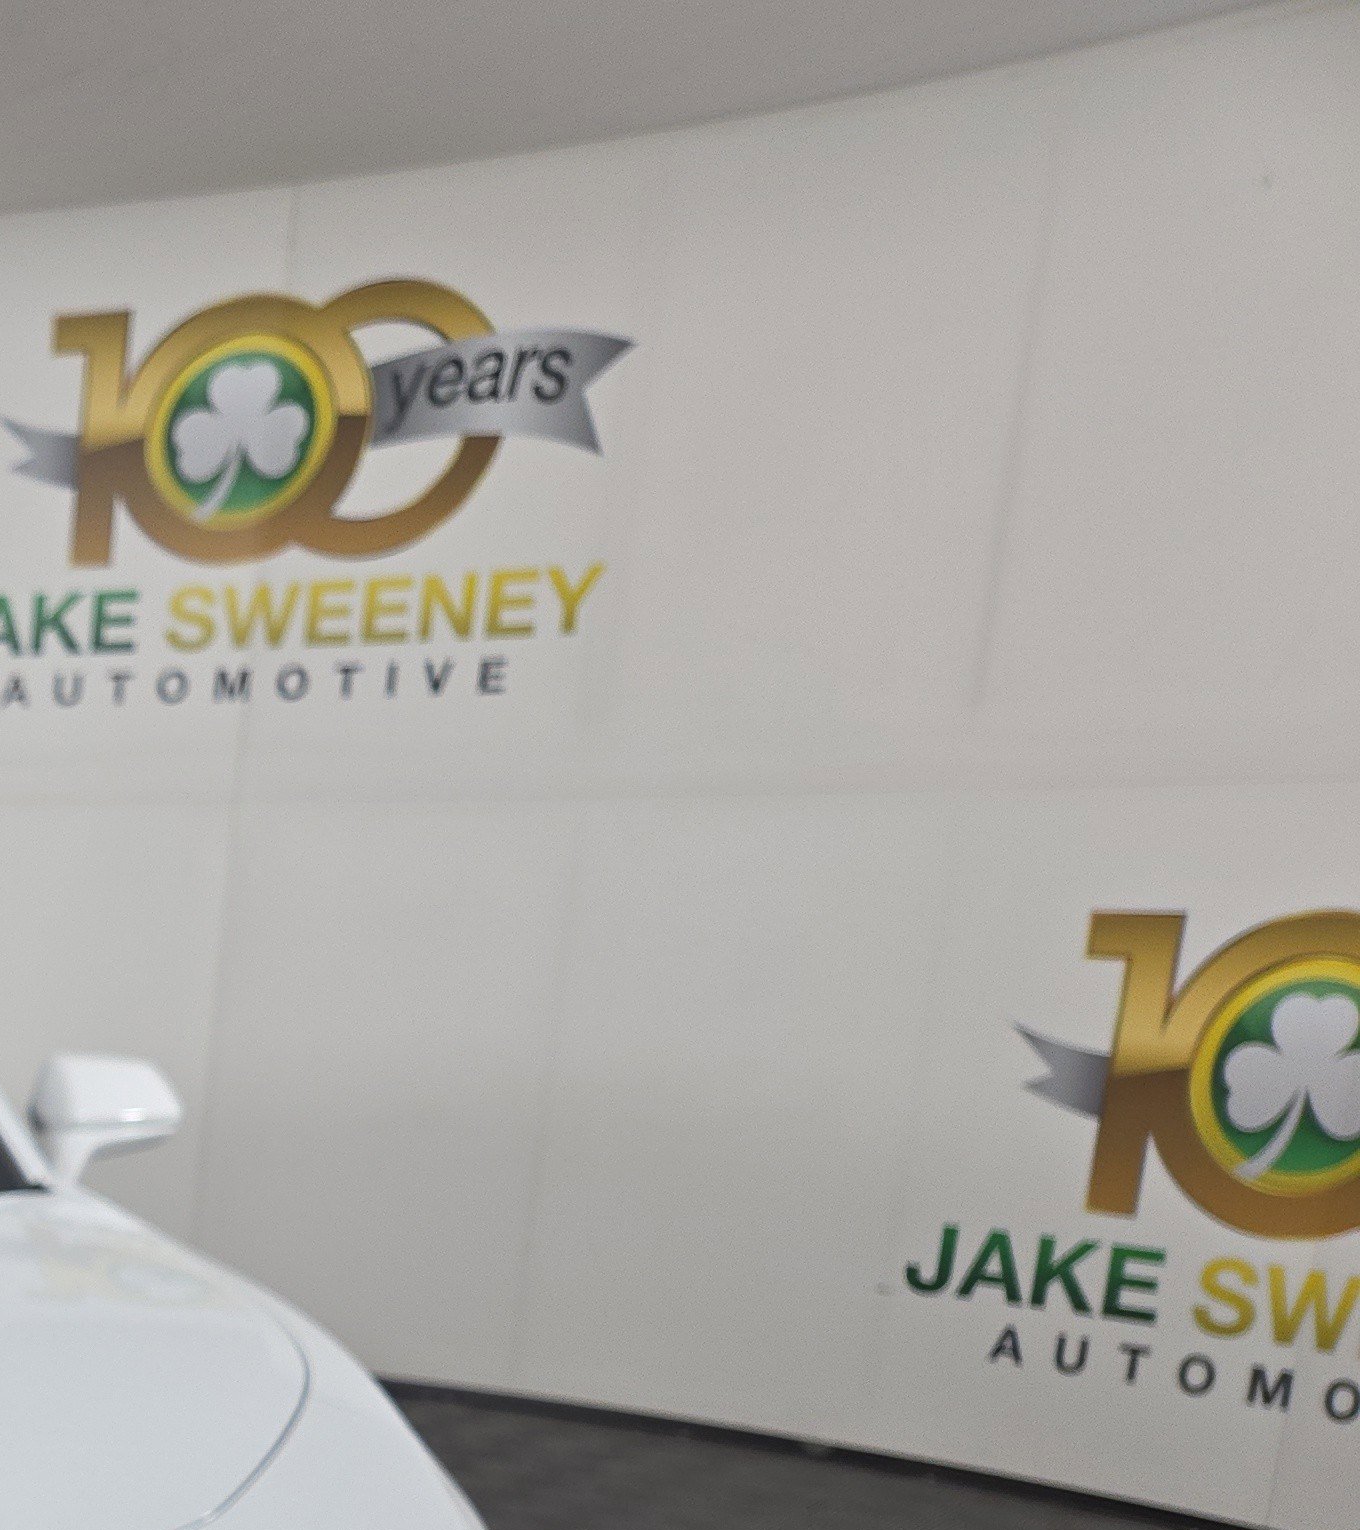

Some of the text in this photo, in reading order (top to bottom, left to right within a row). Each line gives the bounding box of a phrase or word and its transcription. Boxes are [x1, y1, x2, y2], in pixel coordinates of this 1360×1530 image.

[389, 341, 573, 434] years
[164, 562, 606, 654] SWEENEY
[0, 656, 507, 708] AUTOMOTIVE
[905, 1223, 1166, 1324] JAKE
[988, 1322, 1360, 1424] AUTOMO
